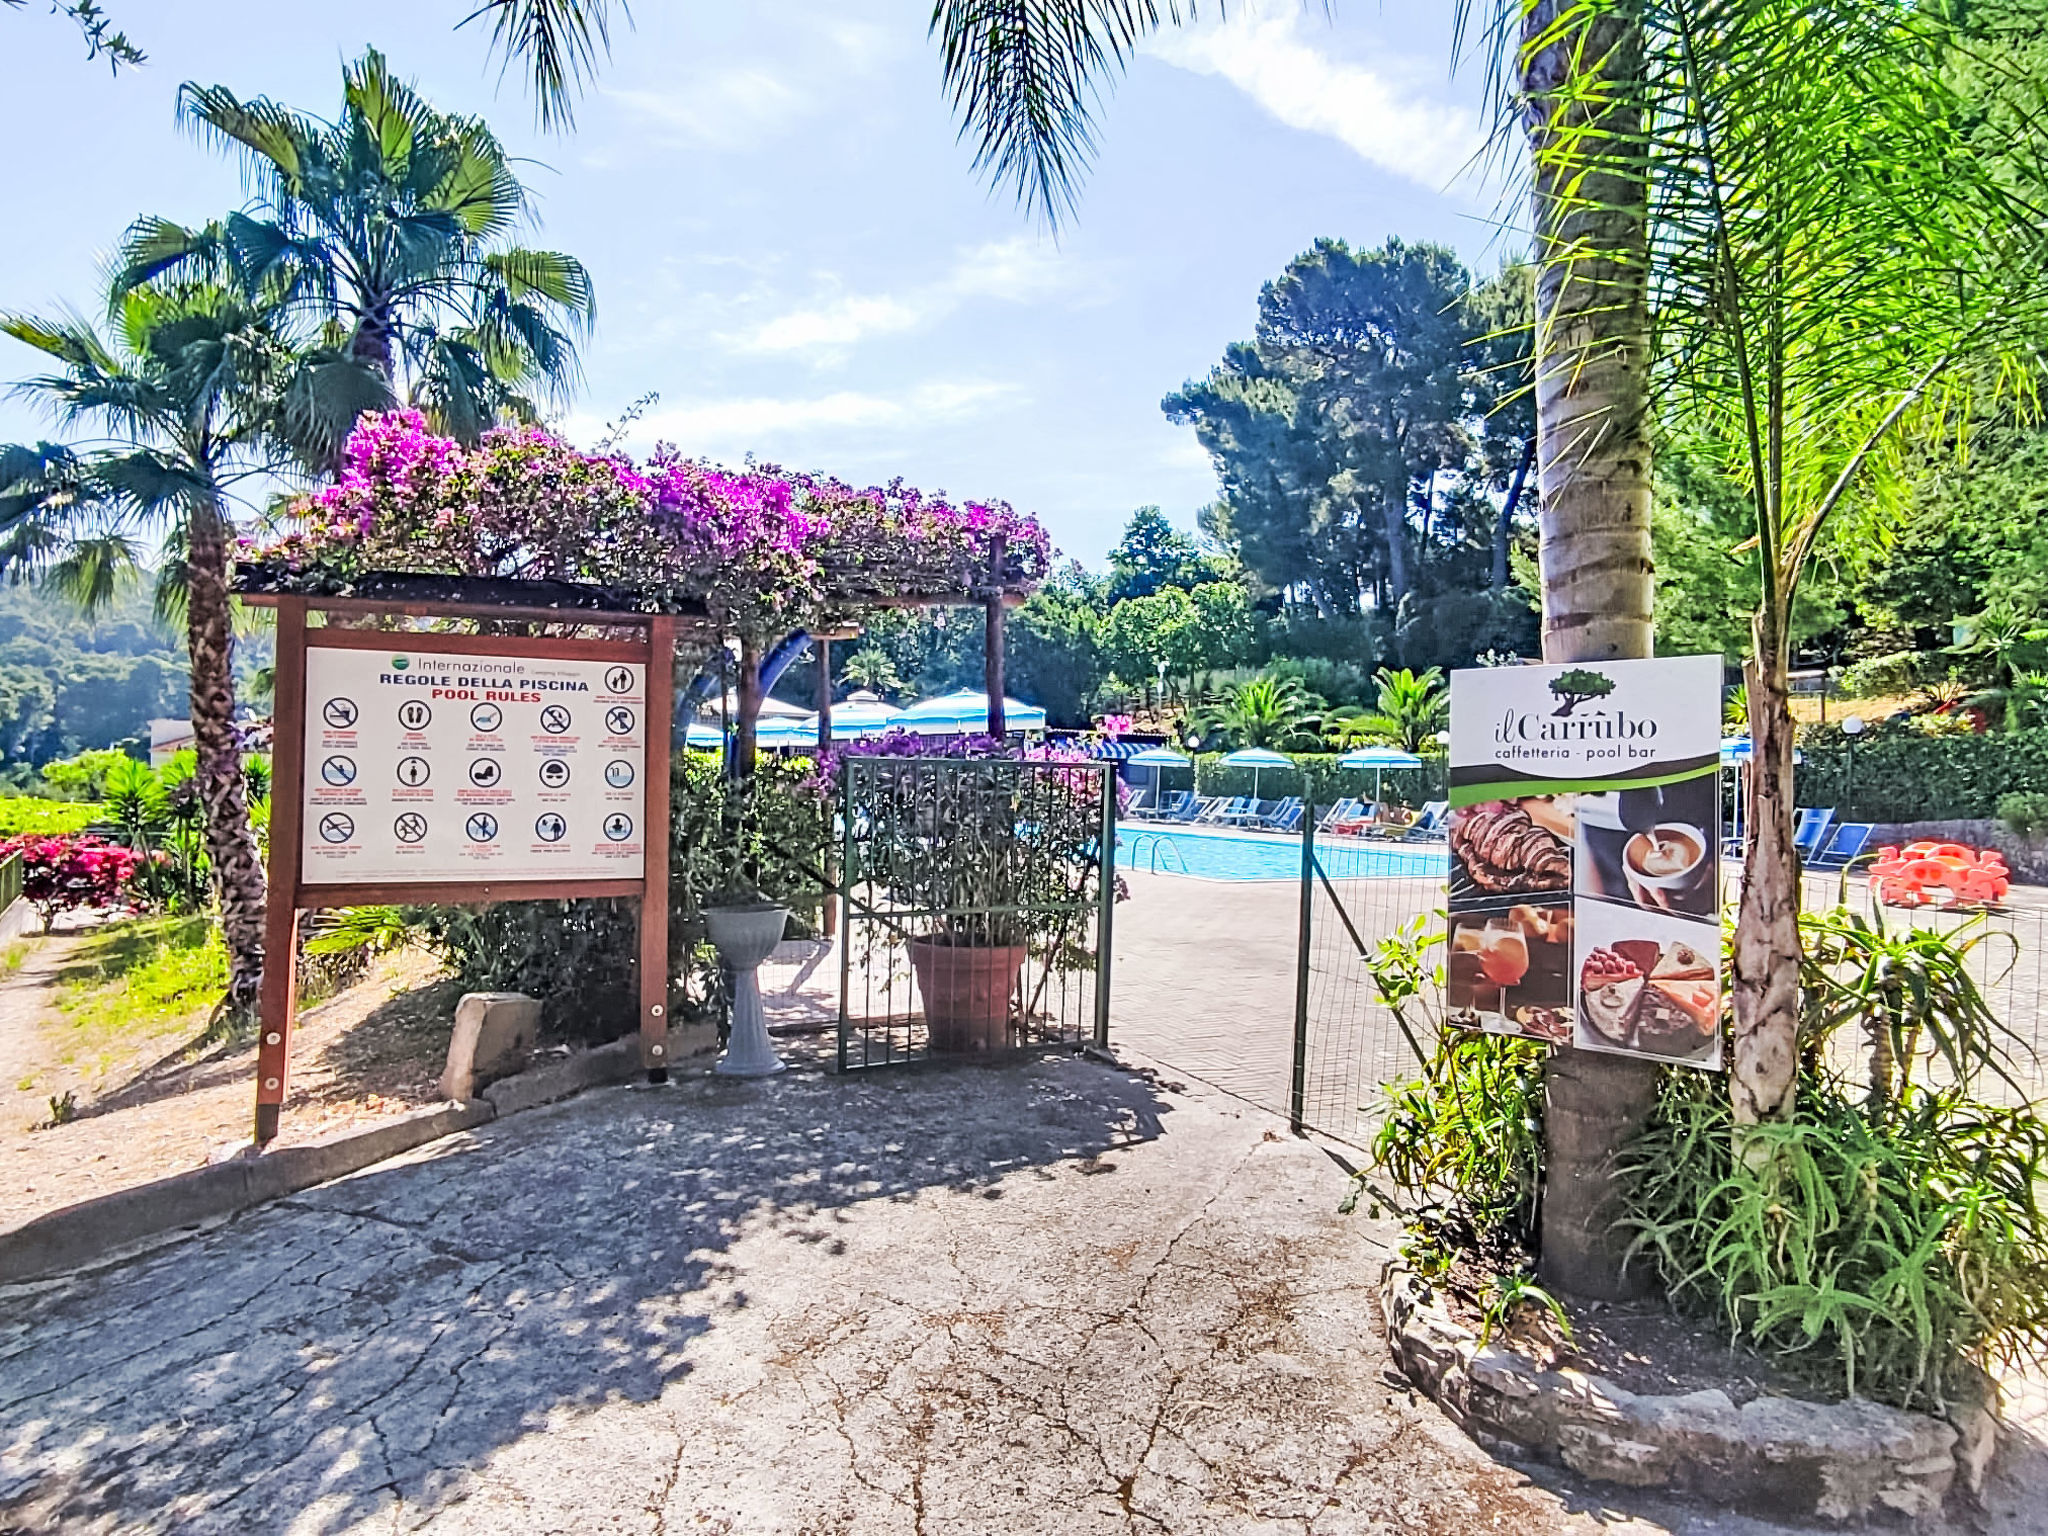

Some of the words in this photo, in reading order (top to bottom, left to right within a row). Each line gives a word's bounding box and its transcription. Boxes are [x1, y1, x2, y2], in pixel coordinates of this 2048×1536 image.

[418, 657, 525, 675] Internazionale
[379, 673, 451, 687] REGOLE
[457, 676, 513, 689] DELLA
[519, 678, 589, 692] PISCINA
[431, 688, 480, 701] POOL
[485, 690, 541, 703] RULES
[1495, 745, 1570, 759] caffetteria
[1586, 744, 1621, 761] pool
[1628, 744, 1656, 758] bar
